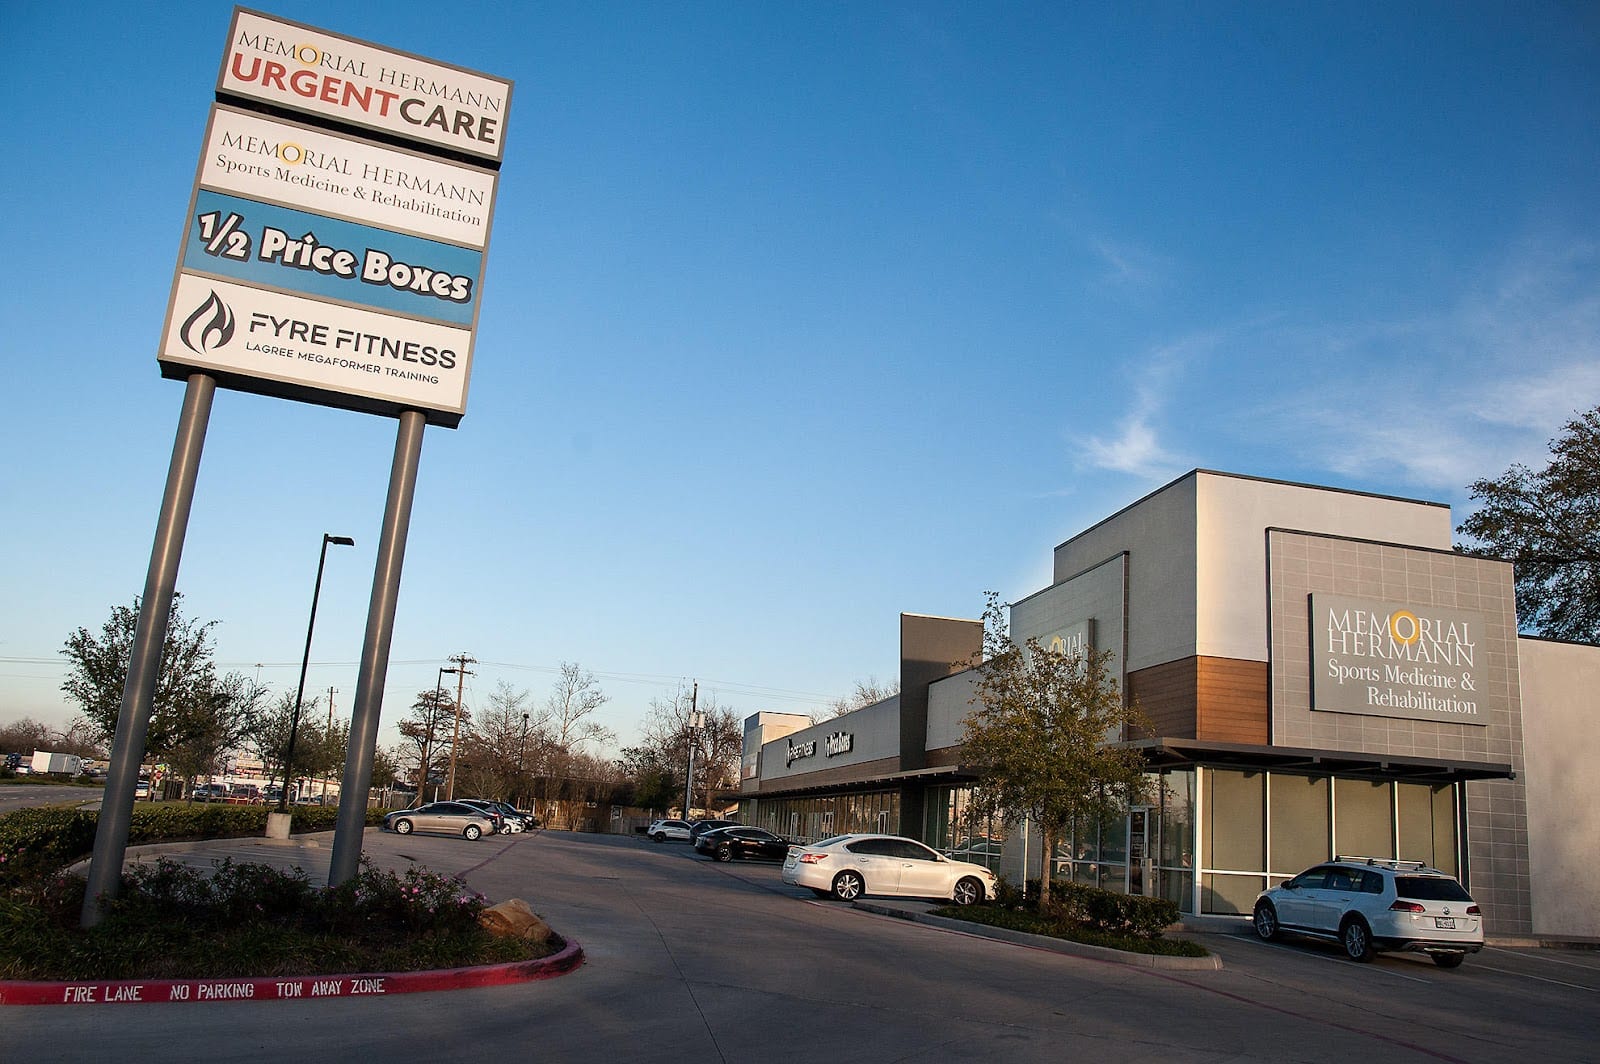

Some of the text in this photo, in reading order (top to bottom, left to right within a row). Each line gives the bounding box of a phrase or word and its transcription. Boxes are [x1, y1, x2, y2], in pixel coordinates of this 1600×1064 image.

[238, 31, 502, 114] MEMORIAL HERMANN
[216, 154, 481, 227] Sports Medicine & Rehabilitation
[221, 131, 485, 207] MEMORIAL HERMANN
[259, 226, 357, 279] Price
[361, 248, 473, 303] Boxes
[246, 341, 439, 385] LAGREE MEGAFORMER TRAINING
[249, 312, 457, 370] FYRE FITNESS
[1328, 607, 1476, 647] MEMORIAL
[1328, 629, 1475, 668] HERMANN
[1328, 658, 1476, 691] Sports Medicine &
[1367, 686, 1478, 715] Rehabilitation
[64, 978, 386, 1002] FIRE LANE NO PARKING TOW AWAY ZONE
